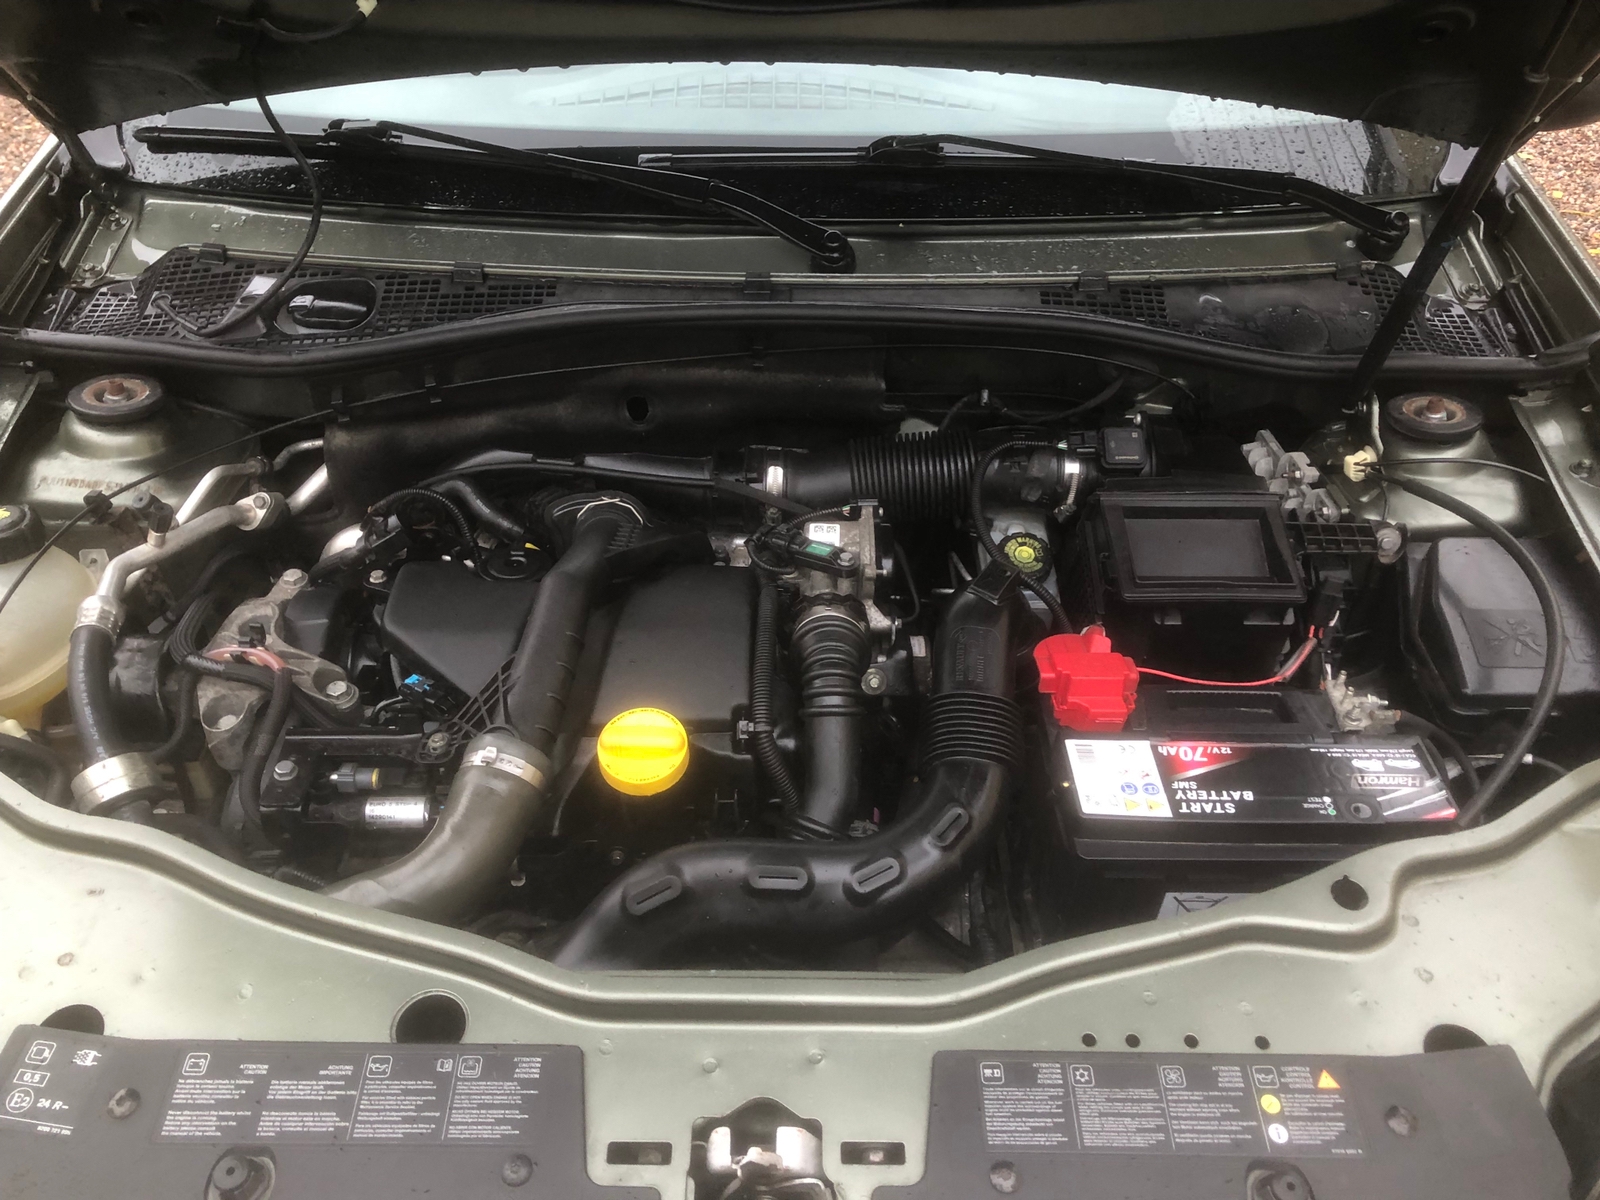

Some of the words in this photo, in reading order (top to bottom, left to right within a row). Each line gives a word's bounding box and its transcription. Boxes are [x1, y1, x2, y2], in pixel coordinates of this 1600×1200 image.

[1171, 781, 1198, 789] SMF
[1357, 775, 1421, 787] Hamron
[1175, 789, 1254, 801] BATTERY
[1178, 802, 1236, 814] START
[22, 1072, 41, 1083] 0,5
[36, 1098, 52, 1109] 24
